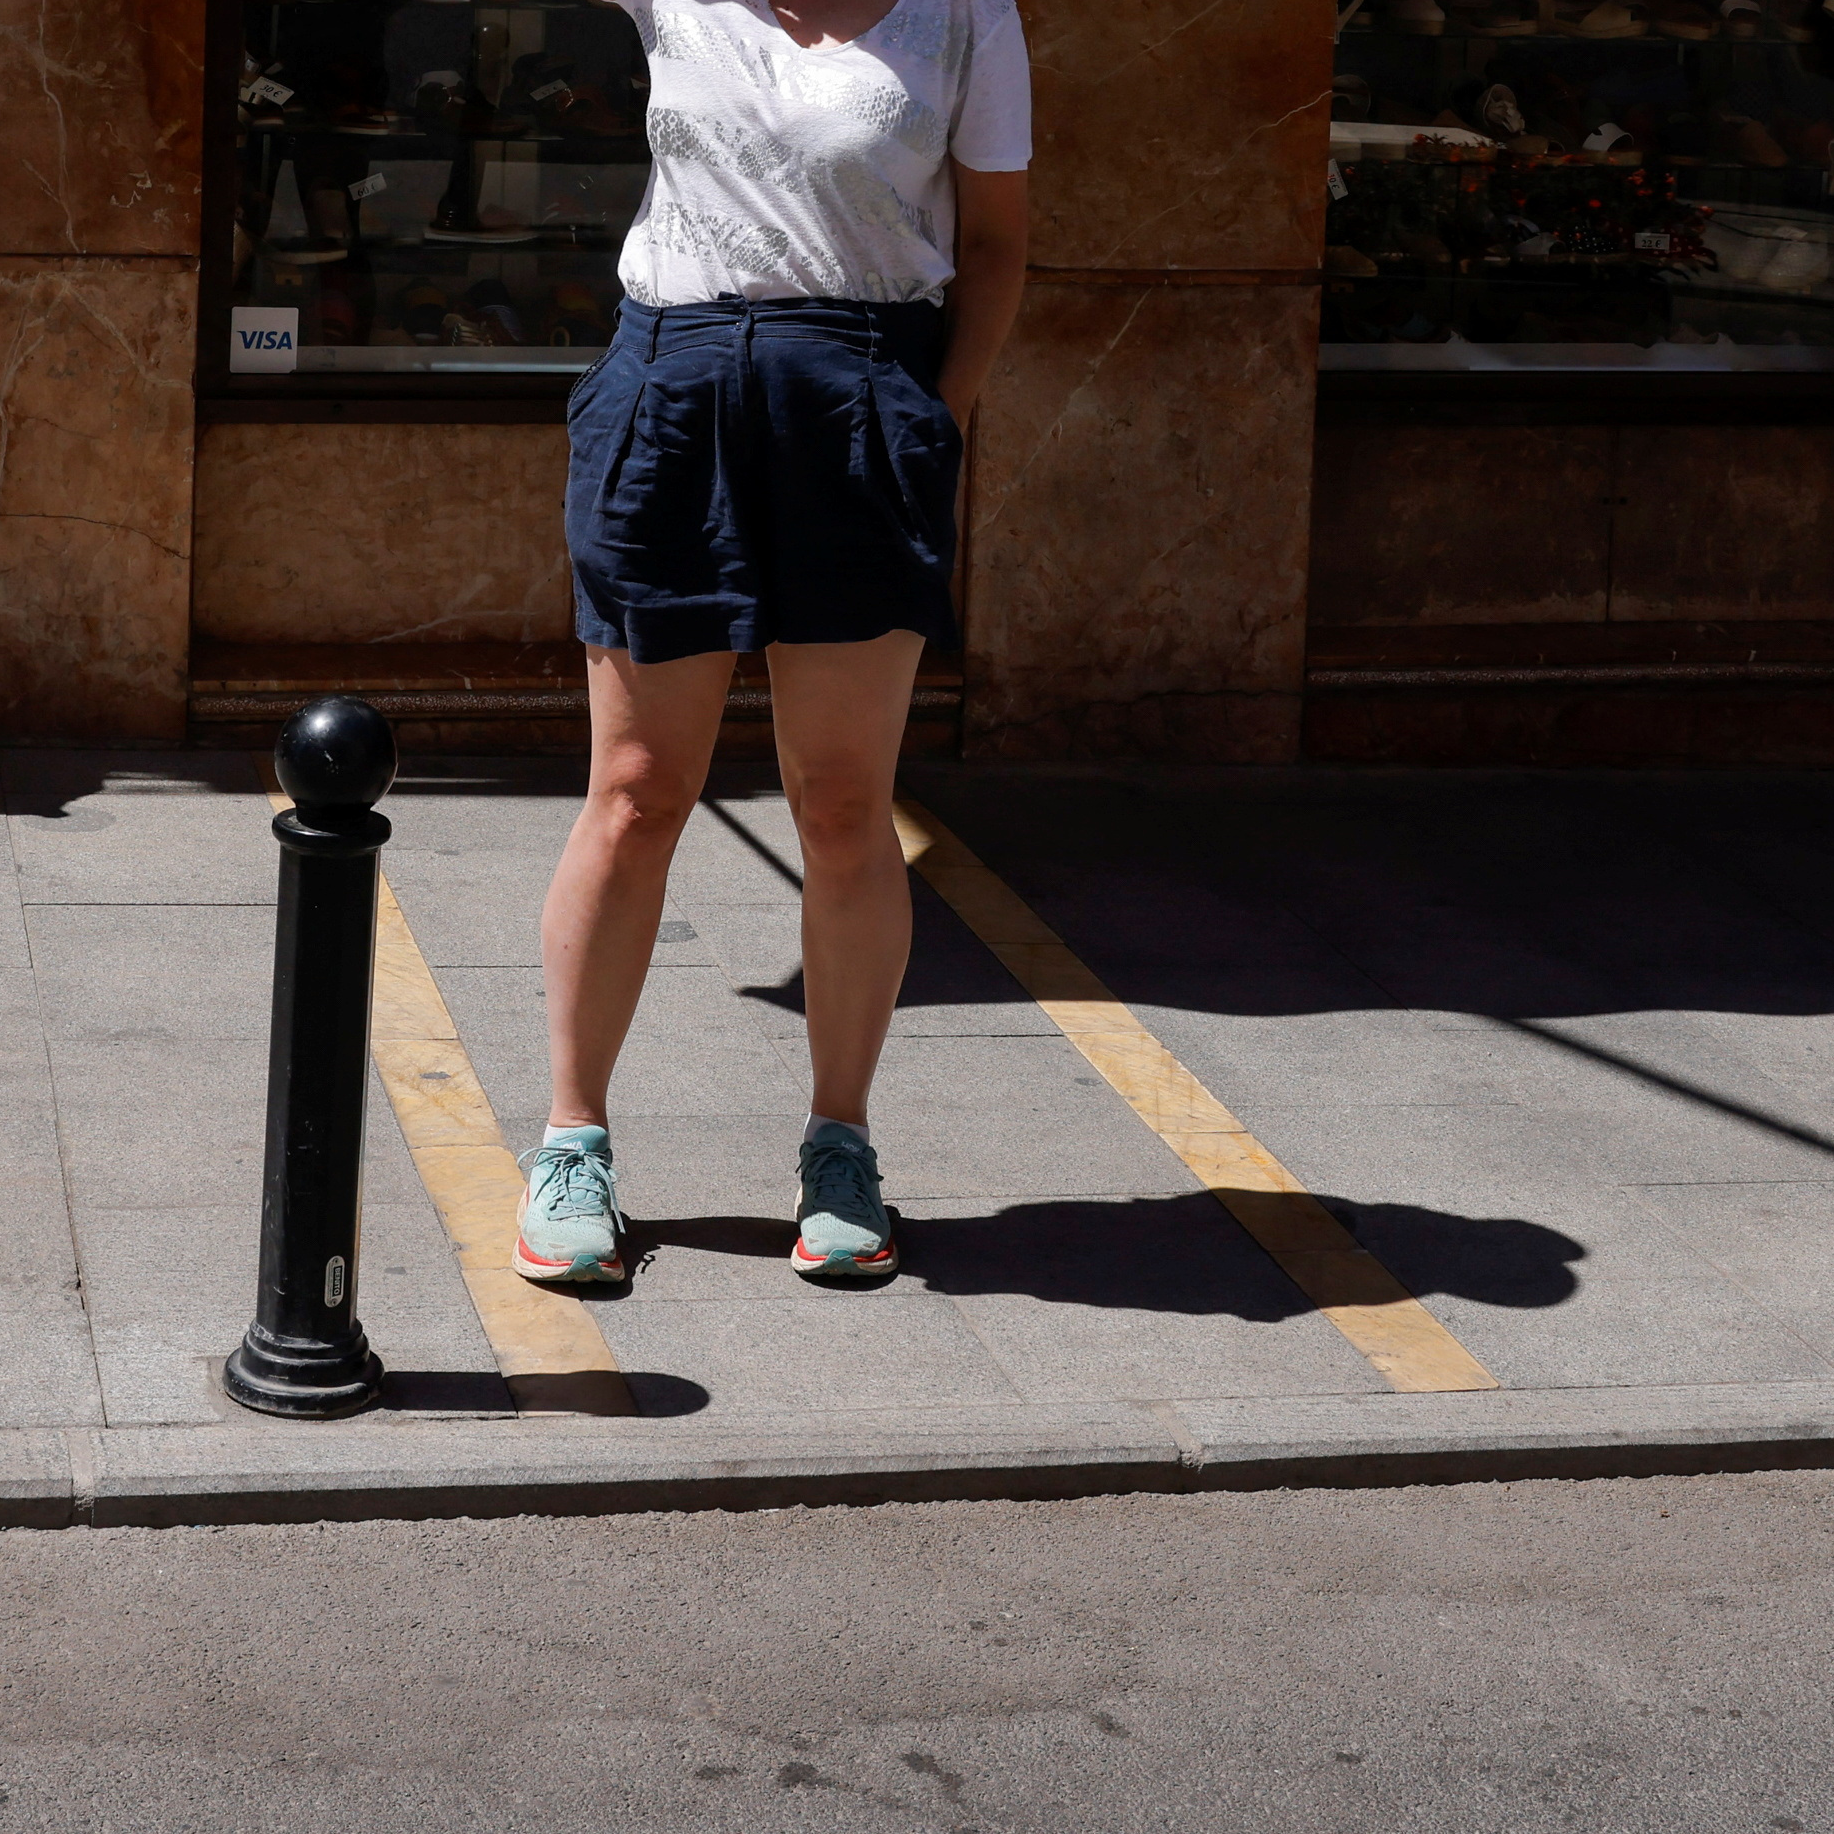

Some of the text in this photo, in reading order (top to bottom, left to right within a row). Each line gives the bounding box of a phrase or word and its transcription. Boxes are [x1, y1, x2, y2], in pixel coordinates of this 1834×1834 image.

[259, 84, 273, 94] 30
[1641, 239, 1653, 248] 22
[236, 330, 293, 350] VISA
[333, 1266, 342, 1296] BENITO
